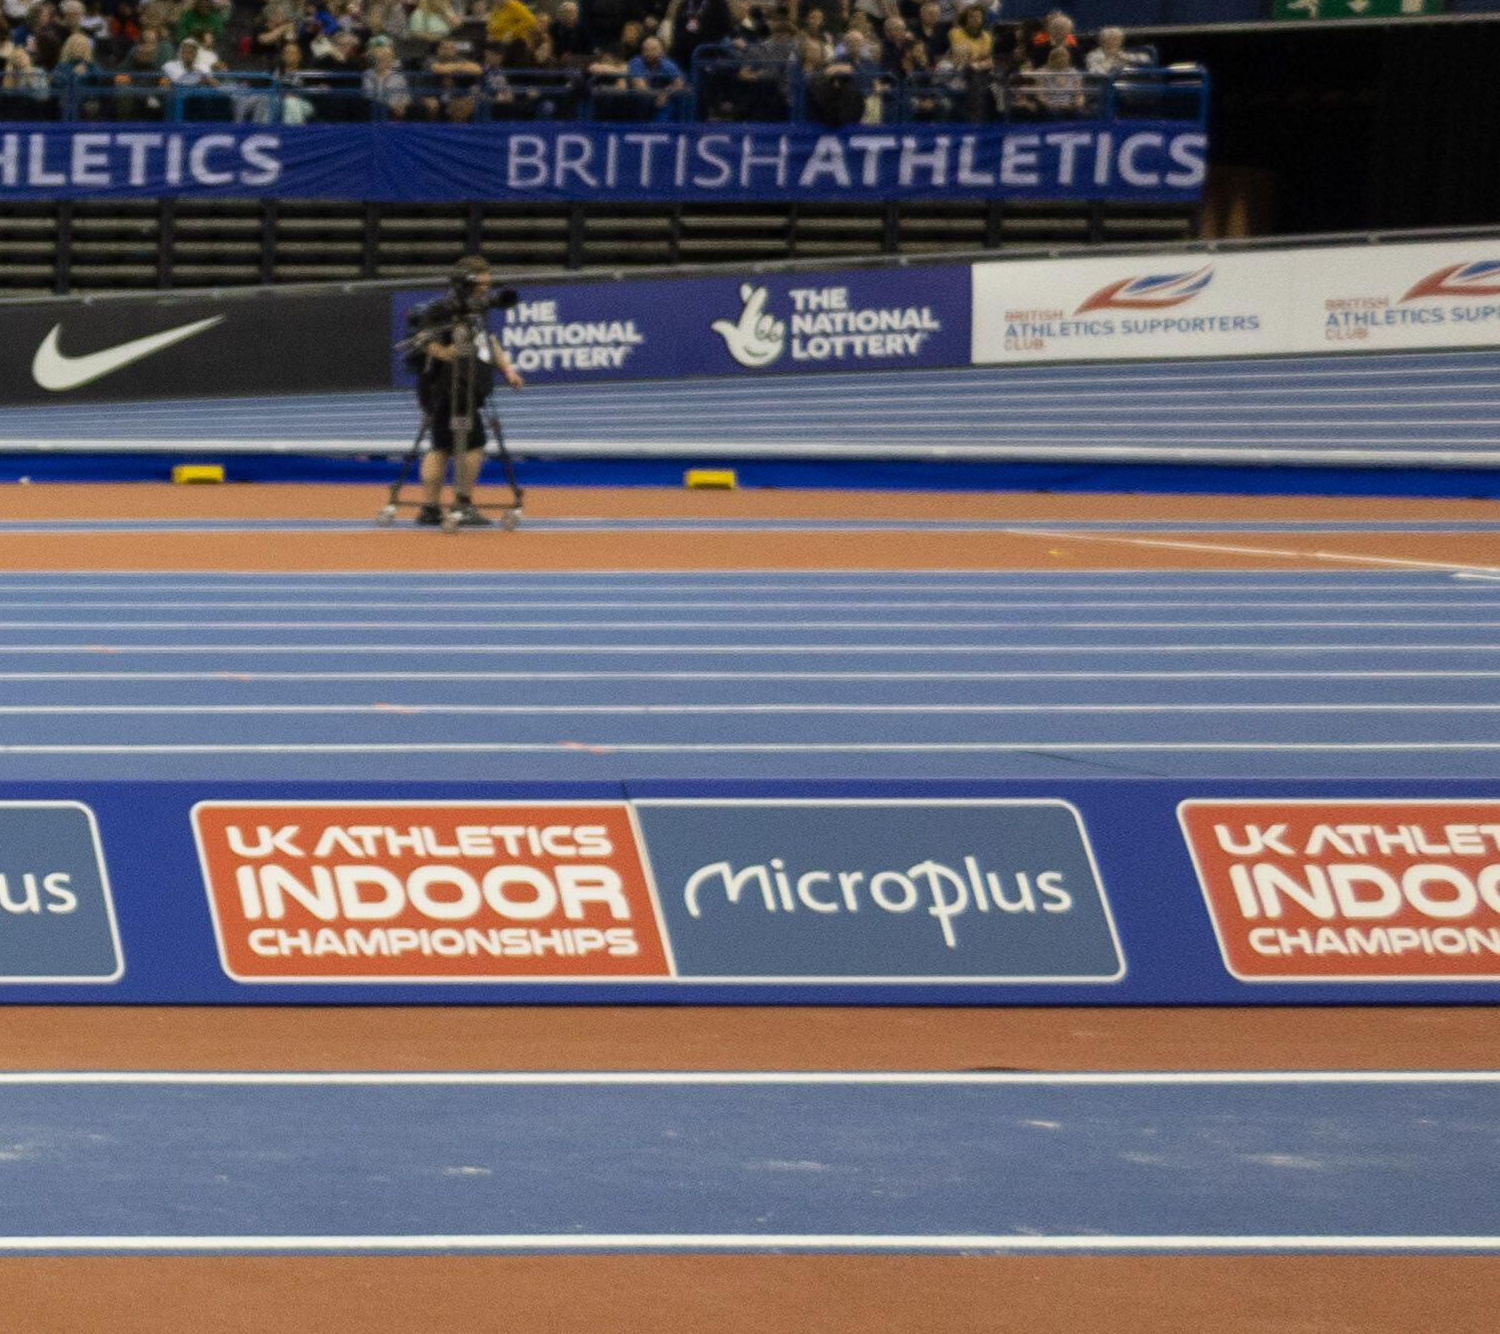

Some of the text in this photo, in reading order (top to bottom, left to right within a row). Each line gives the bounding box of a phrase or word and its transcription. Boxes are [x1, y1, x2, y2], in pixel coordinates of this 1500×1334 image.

[789, 288, 849, 311] THE
[791, 305, 940, 336] NATIONAL
[1004, 308, 1063, 323] BRITISH
[1005, 315, 1260, 337] ATHLETICS SUPPORTERS
[1325, 305, 1500, 328] ATHLETICS SUP
[502, 320, 645, 348] NATIONAL
[792, 332, 926, 361] LOTTERY
[1004, 336, 1045, 351] CLUB
[504, 346, 634, 374] LOTTERY
[226, 824, 614, 858] UK ATHLETICS
[1215, 823, 1296, 856] UK
[236, 864, 631, 921] INDOOR
[684, 856, 1074, 948] Microplus
[249, 928, 640, 957] CHAMPIONSHIPS
